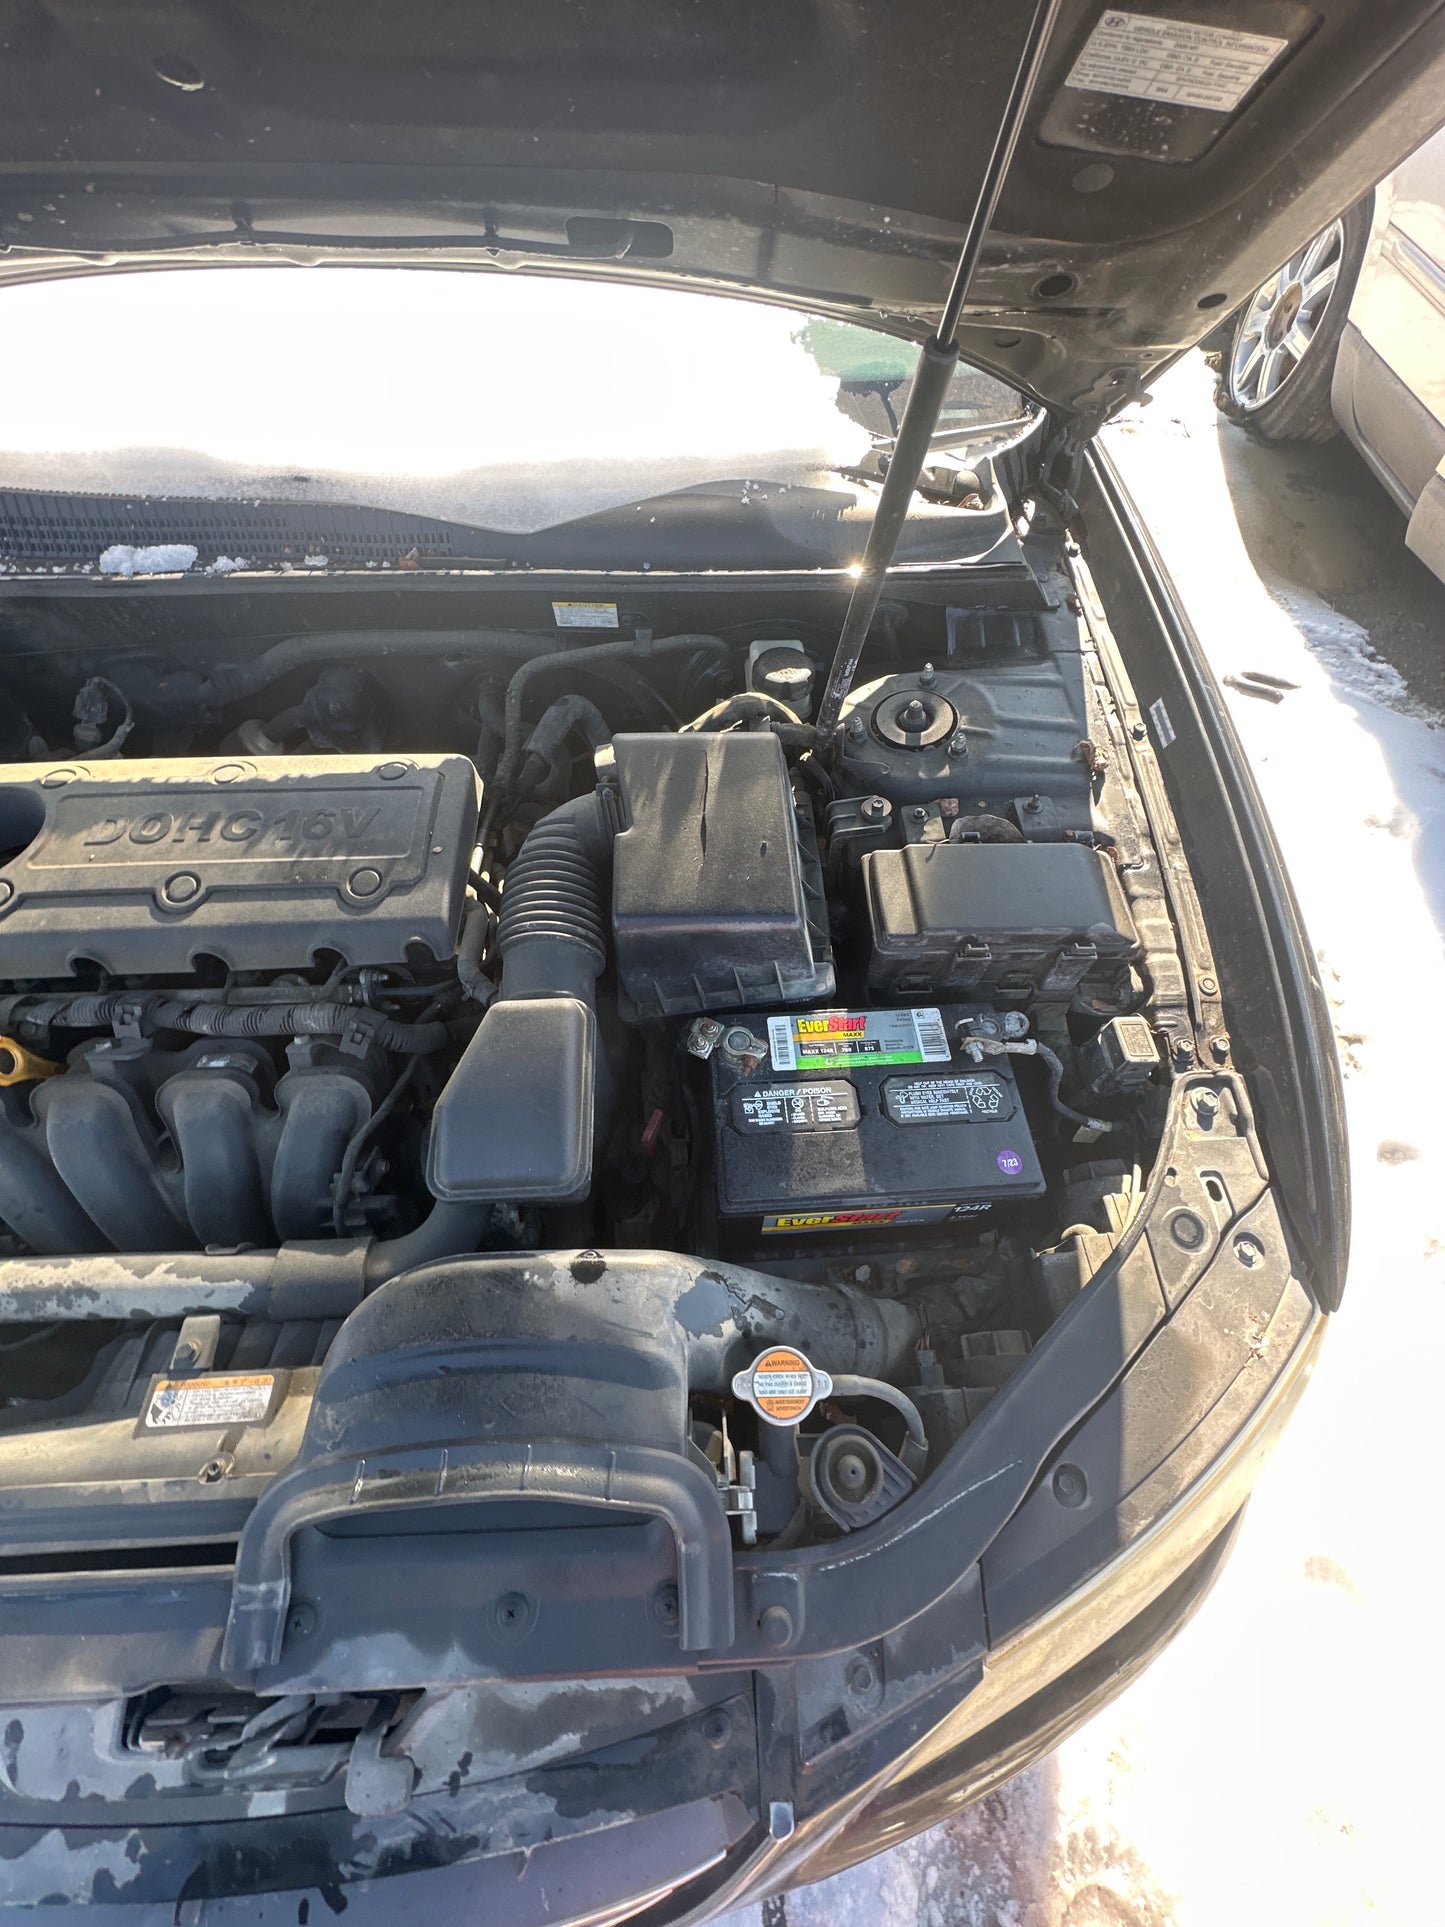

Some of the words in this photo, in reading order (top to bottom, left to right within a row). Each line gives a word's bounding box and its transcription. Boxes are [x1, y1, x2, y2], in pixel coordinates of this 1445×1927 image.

[84, 810, 262, 846] DOHC
[271, 807, 381, 841] 16V
[796, 1015, 867, 1034] EverStart
[802, 1048, 820, 1056] MAXX
[762, 1089, 795, 1098] DANGER
[803, 1087, 832, 1095] POISON
[954, 1204, 993, 1213] 124R
[775, 1211, 902, 1228] EverStart
